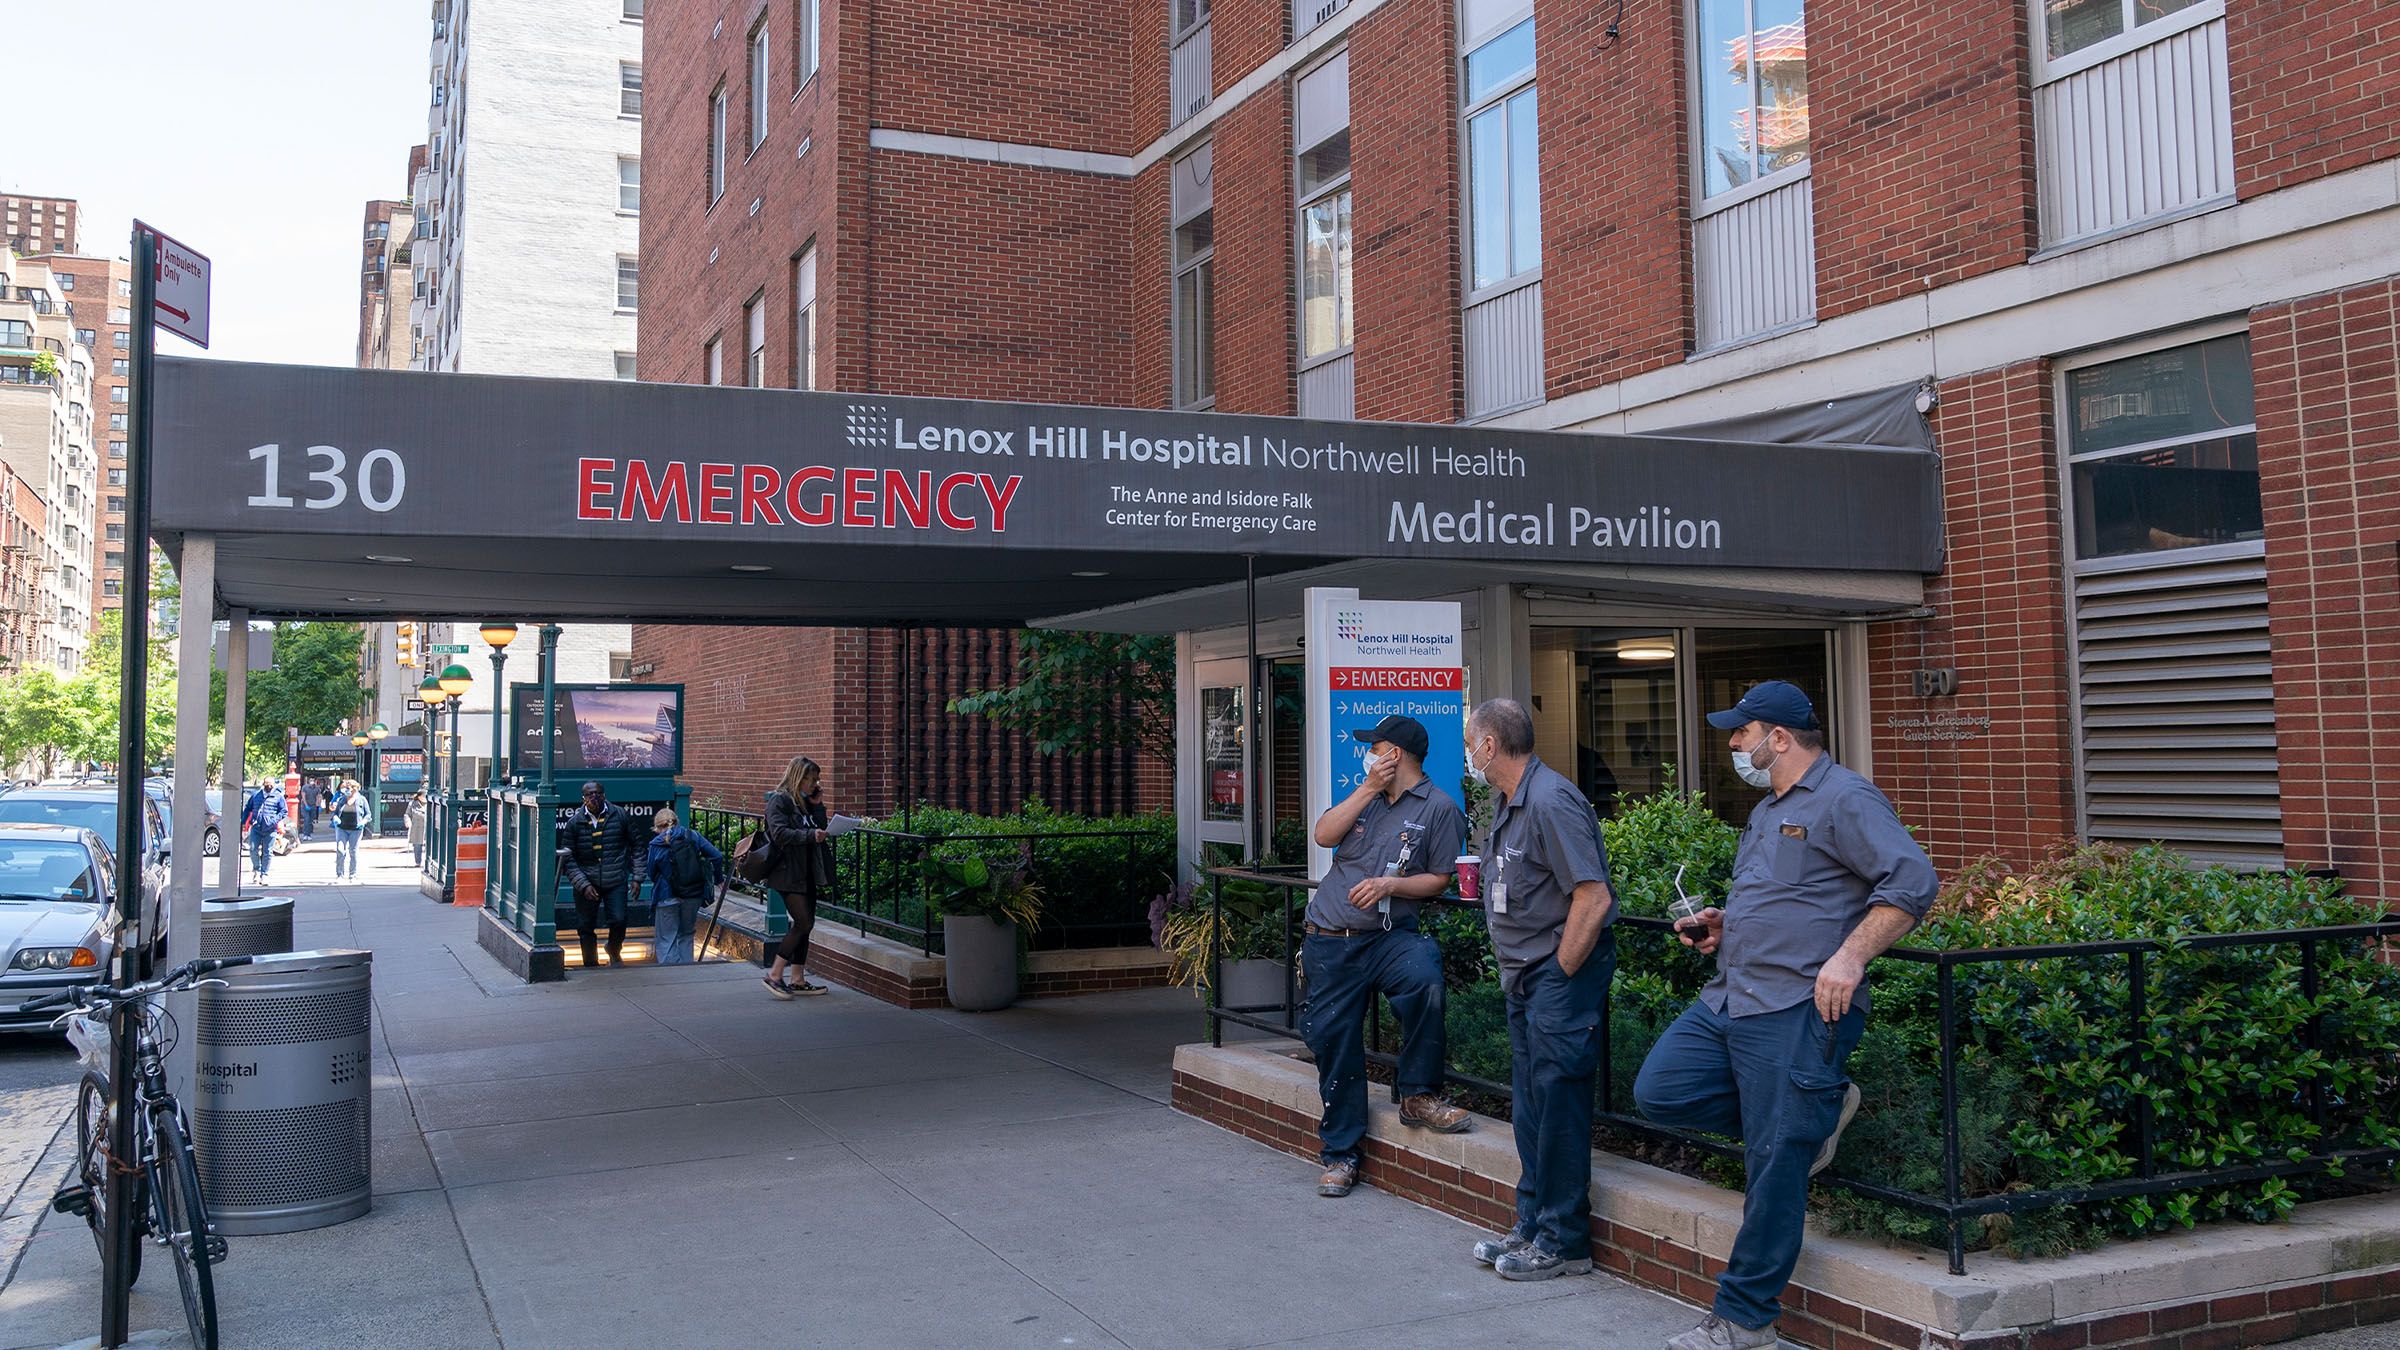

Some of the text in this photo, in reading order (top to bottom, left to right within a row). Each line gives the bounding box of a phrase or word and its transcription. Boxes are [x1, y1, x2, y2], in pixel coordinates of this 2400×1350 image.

[165, 248, 202, 279] Ambulette
[164, 264, 181, 286] Only
[895, 417, 1526, 478] Lenox Hill Hospital Northwell Health
[246, 443, 406, 513] 130
[576, 456, 1023, 533] EMERGENCY
[1111, 486, 1313, 510] The Anne and Isidore Falk
[1105, 509, 1317, 534] Center for Emergency Care
[1387, 499, 1721, 550] Medical Pavilion
[1357, 633, 1453, 646] Lenox Hill Hospital
[432, 645, 462, 654] LEXINGTON
[1357, 645, 1442, 657] Northwell Health
[1351, 670, 1454, 688] EMERGENCY
[1352, 701, 1458, 715] Medical Pavilion
[1888, 715, 1920, 728] Steven
[1935, 712, 1991, 729] Greenberg
[527, 726, 562, 736] ede
[1903, 727, 1976, 741] Guest Services
[381, 754, 421, 763] INJURE
[465, 811, 480, 822] 77
[202, 1062, 257, 1079] Hospital
[200, 1079, 234, 1095] Health
